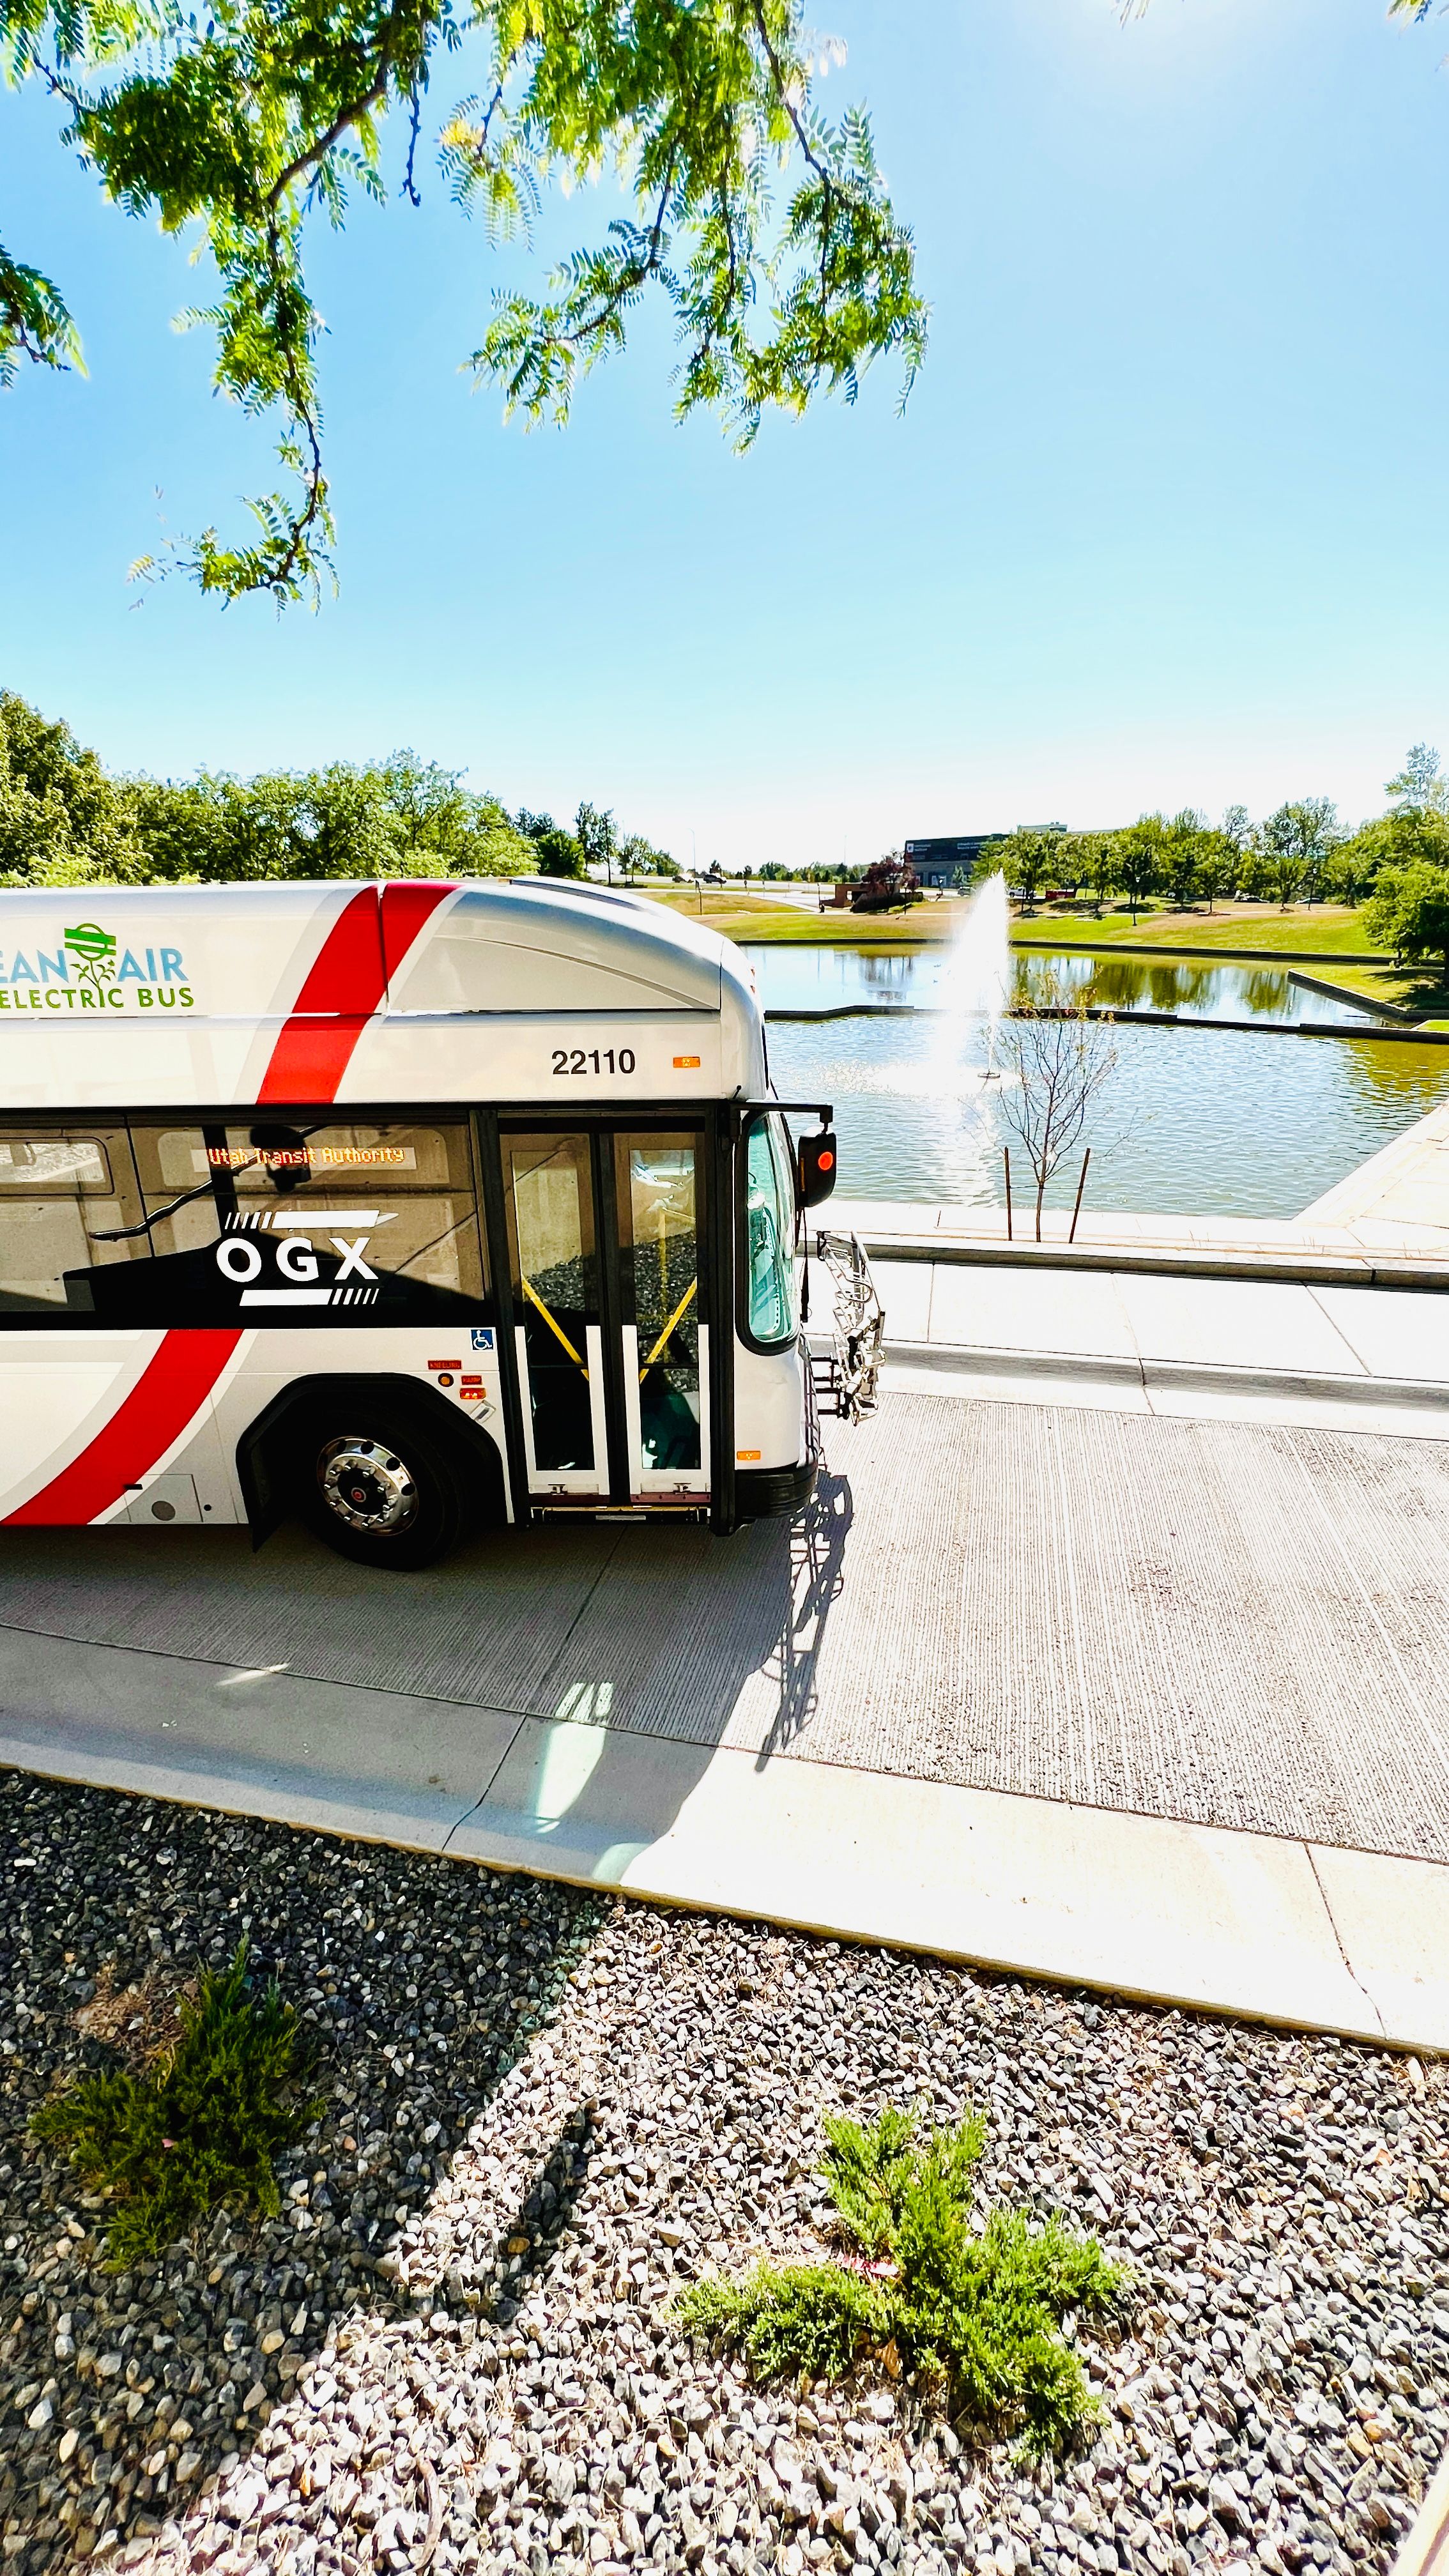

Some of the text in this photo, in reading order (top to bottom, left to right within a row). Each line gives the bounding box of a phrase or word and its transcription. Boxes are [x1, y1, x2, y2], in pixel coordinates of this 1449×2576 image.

[117, 948, 189, 982] AIR
[0, 987, 194, 1008] ELECTRIC BUS
[551, 1048, 636, 1075] 22110
[208, 1146, 404, 1165] Utah Transit Authority
[216, 1236, 379, 1283] OGX
